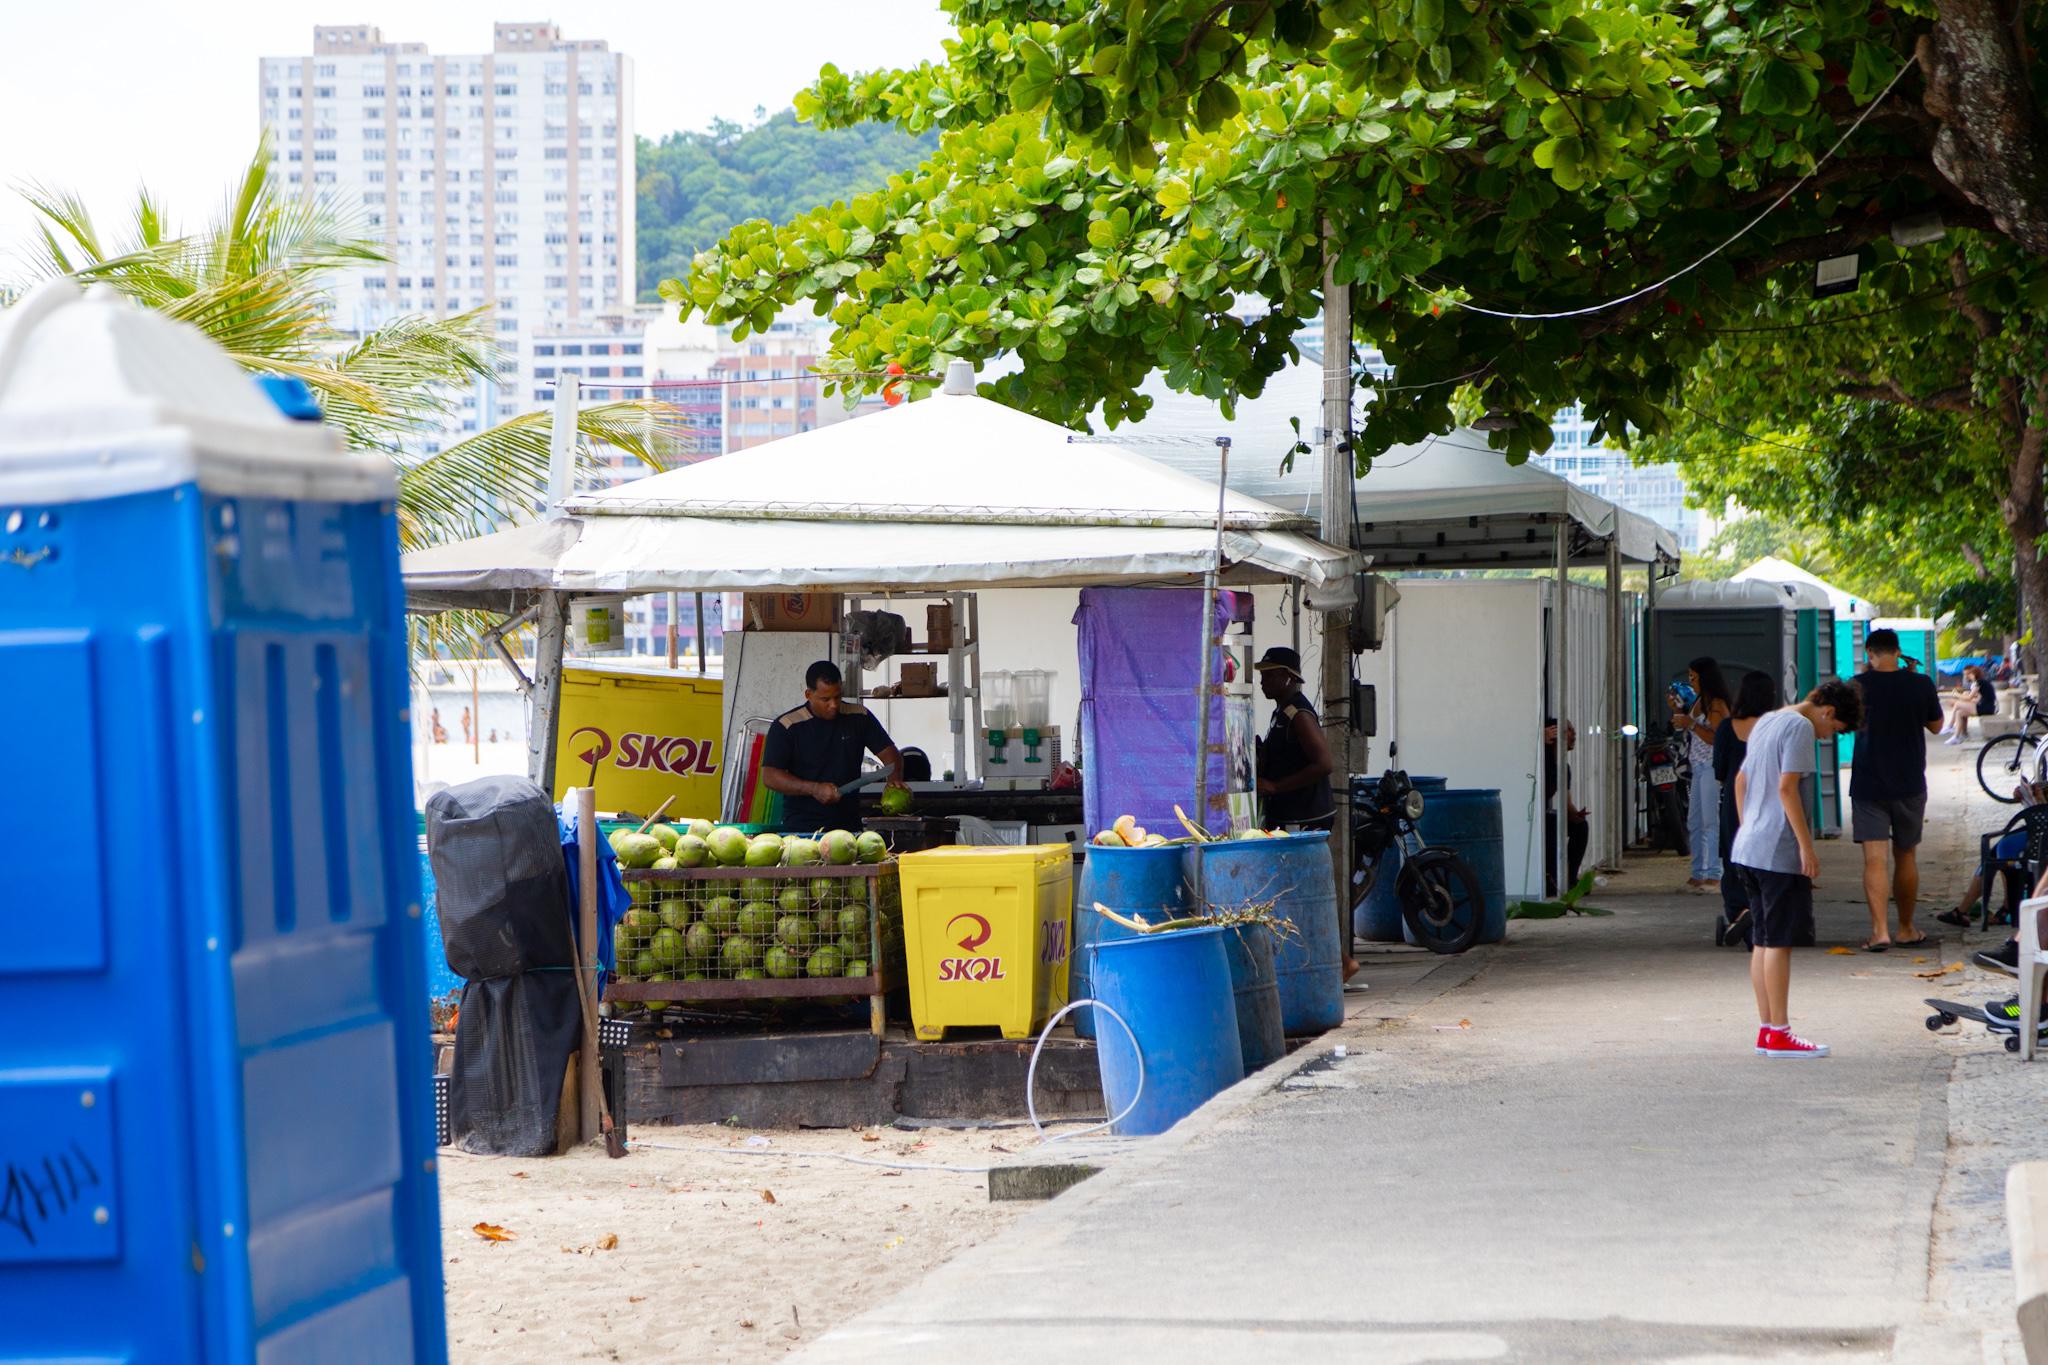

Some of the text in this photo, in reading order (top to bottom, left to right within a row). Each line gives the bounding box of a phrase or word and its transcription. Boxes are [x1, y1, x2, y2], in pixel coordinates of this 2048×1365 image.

[615, 732, 719, 777] SKOL
[1048, 920, 1067, 964] SKOL
[938, 957, 1005, 983] SKOL
